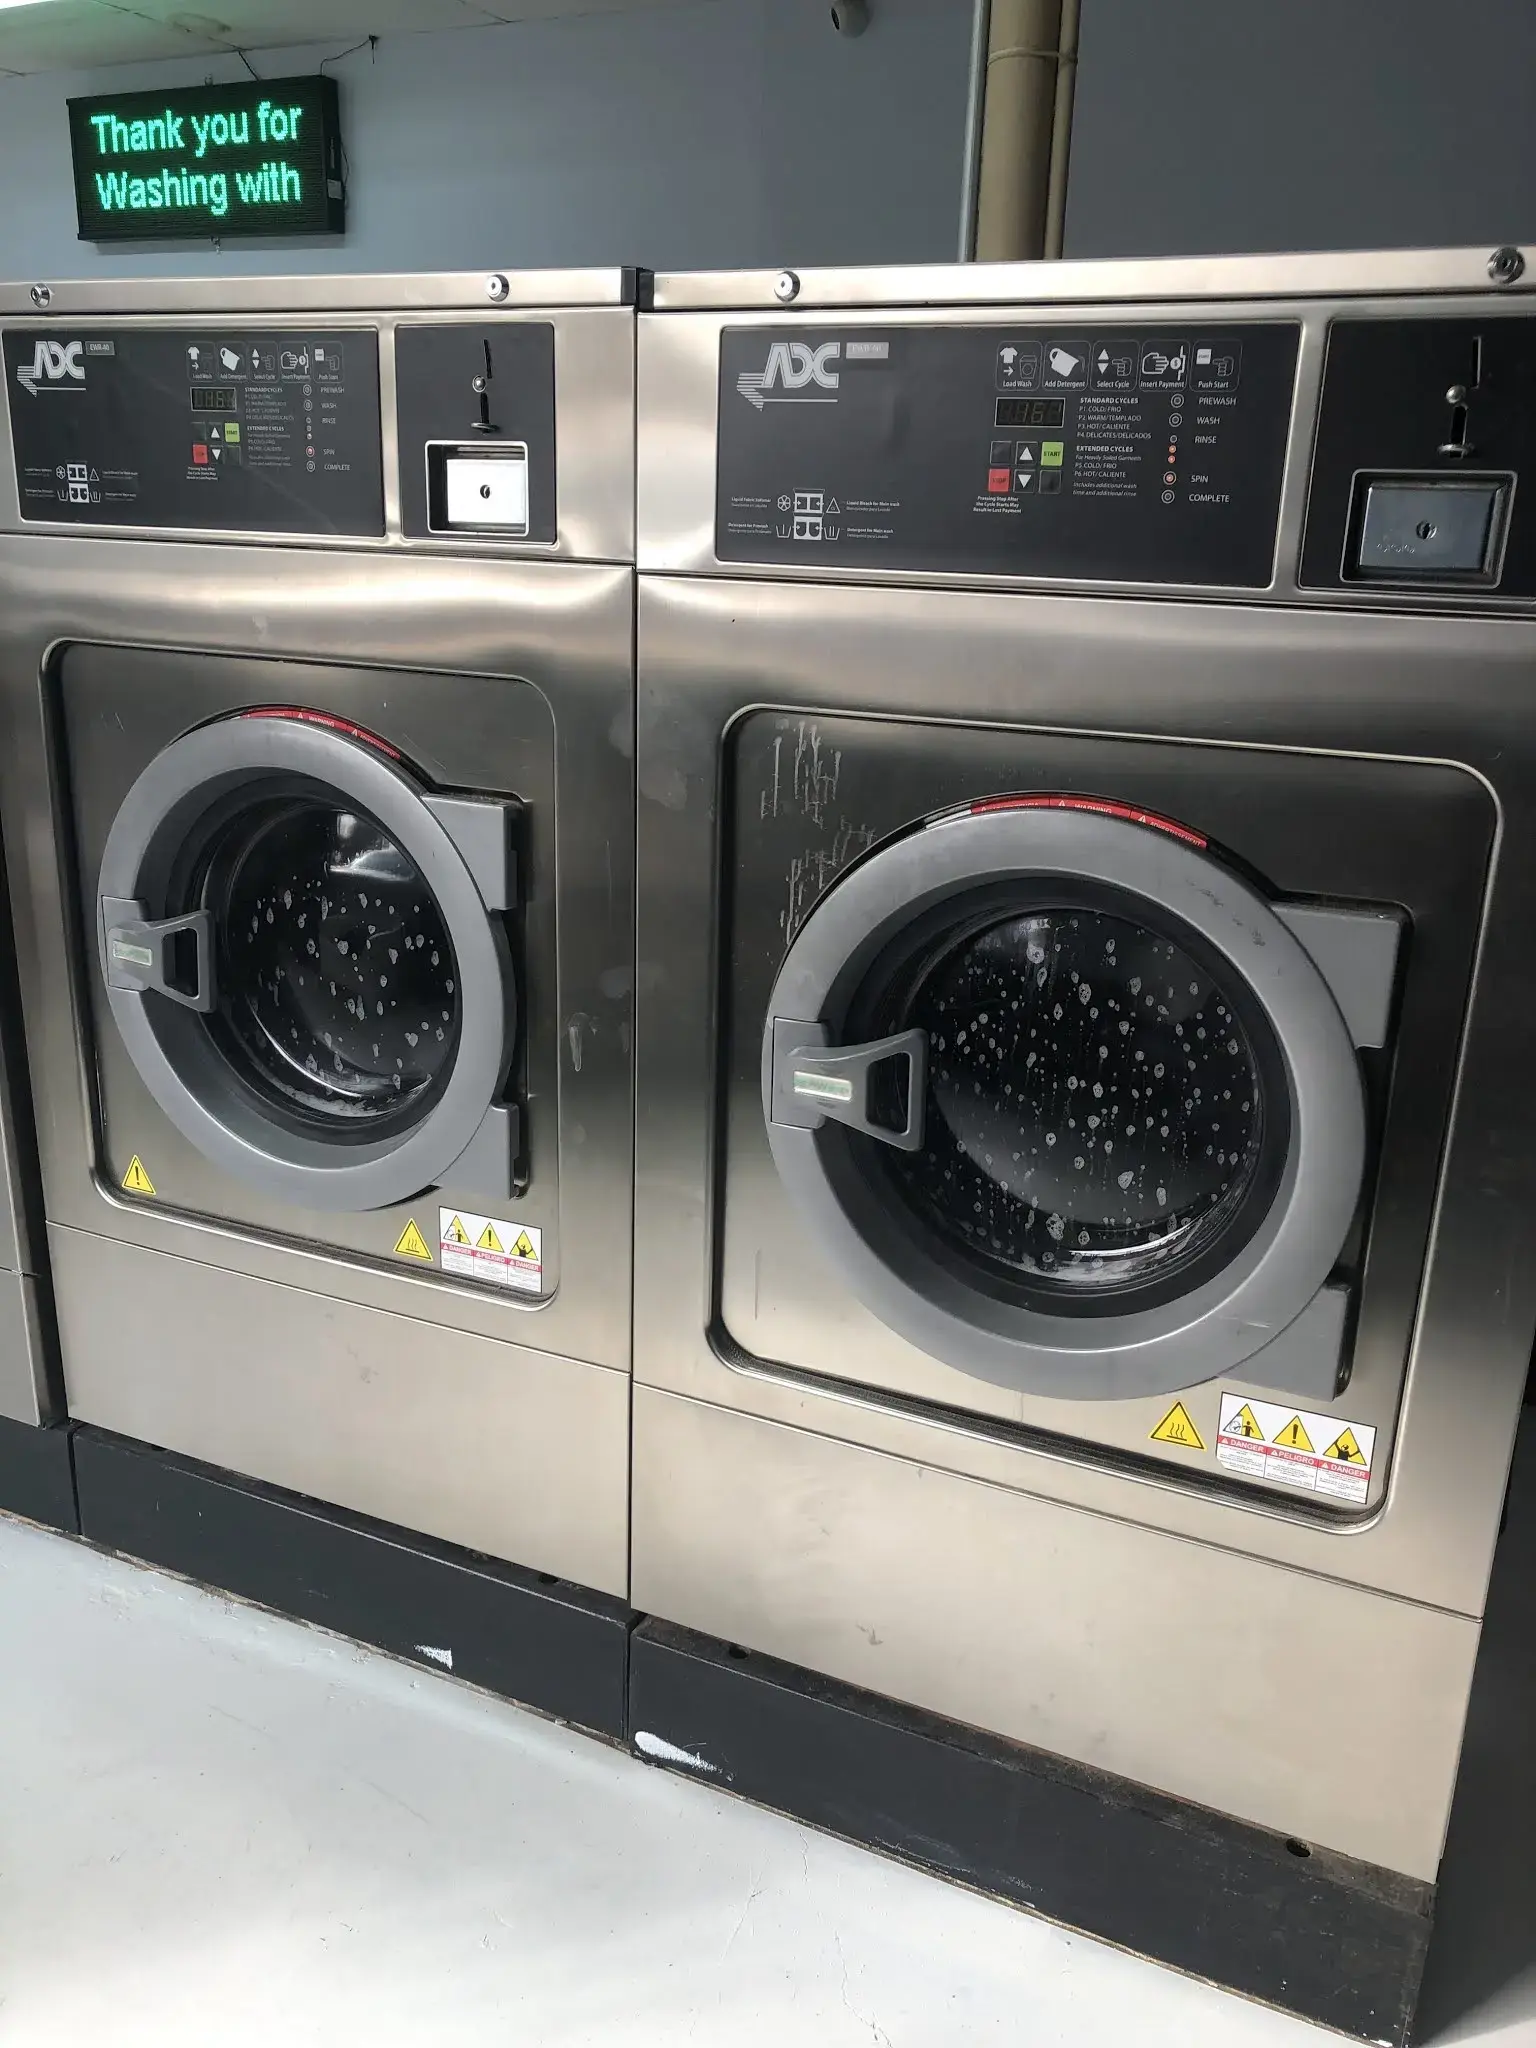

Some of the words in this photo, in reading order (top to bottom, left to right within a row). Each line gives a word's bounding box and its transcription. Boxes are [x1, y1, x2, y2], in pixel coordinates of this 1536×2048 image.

[90, 109, 185, 154] Thank
[191, 111, 249, 157] you
[257, 101, 302, 141] for
[95, 167, 228, 216] Washing
[236, 161, 301, 202] with
[34, 341, 85, 379] ADC
[762, 342, 840, 388] ADC
[1057, 381, 1085, 389] Detergent
[1115, 381, 1130, 389] Cycle
[1158, 381, 1184, 389] Payment
[1198, 397, 1237, 406] PREWASH
[1196, 416, 1221, 425] WASH
[1195, 436, 1217, 444] RINSE
[1190, 475, 1209, 483] SPIN
[1188, 493, 1230, 503] COMPLETE
[449, 1245, 472, 1255] DANGER
[480, 1253, 506, 1263] PELIGRO
[516, 1262, 539, 1271] DANGER
[1230, 1440, 1264, 1453] DANGER
[1278, 1451, 1315, 1465] PELIGRO
[1331, 1464, 1366, 1478] DANGER
